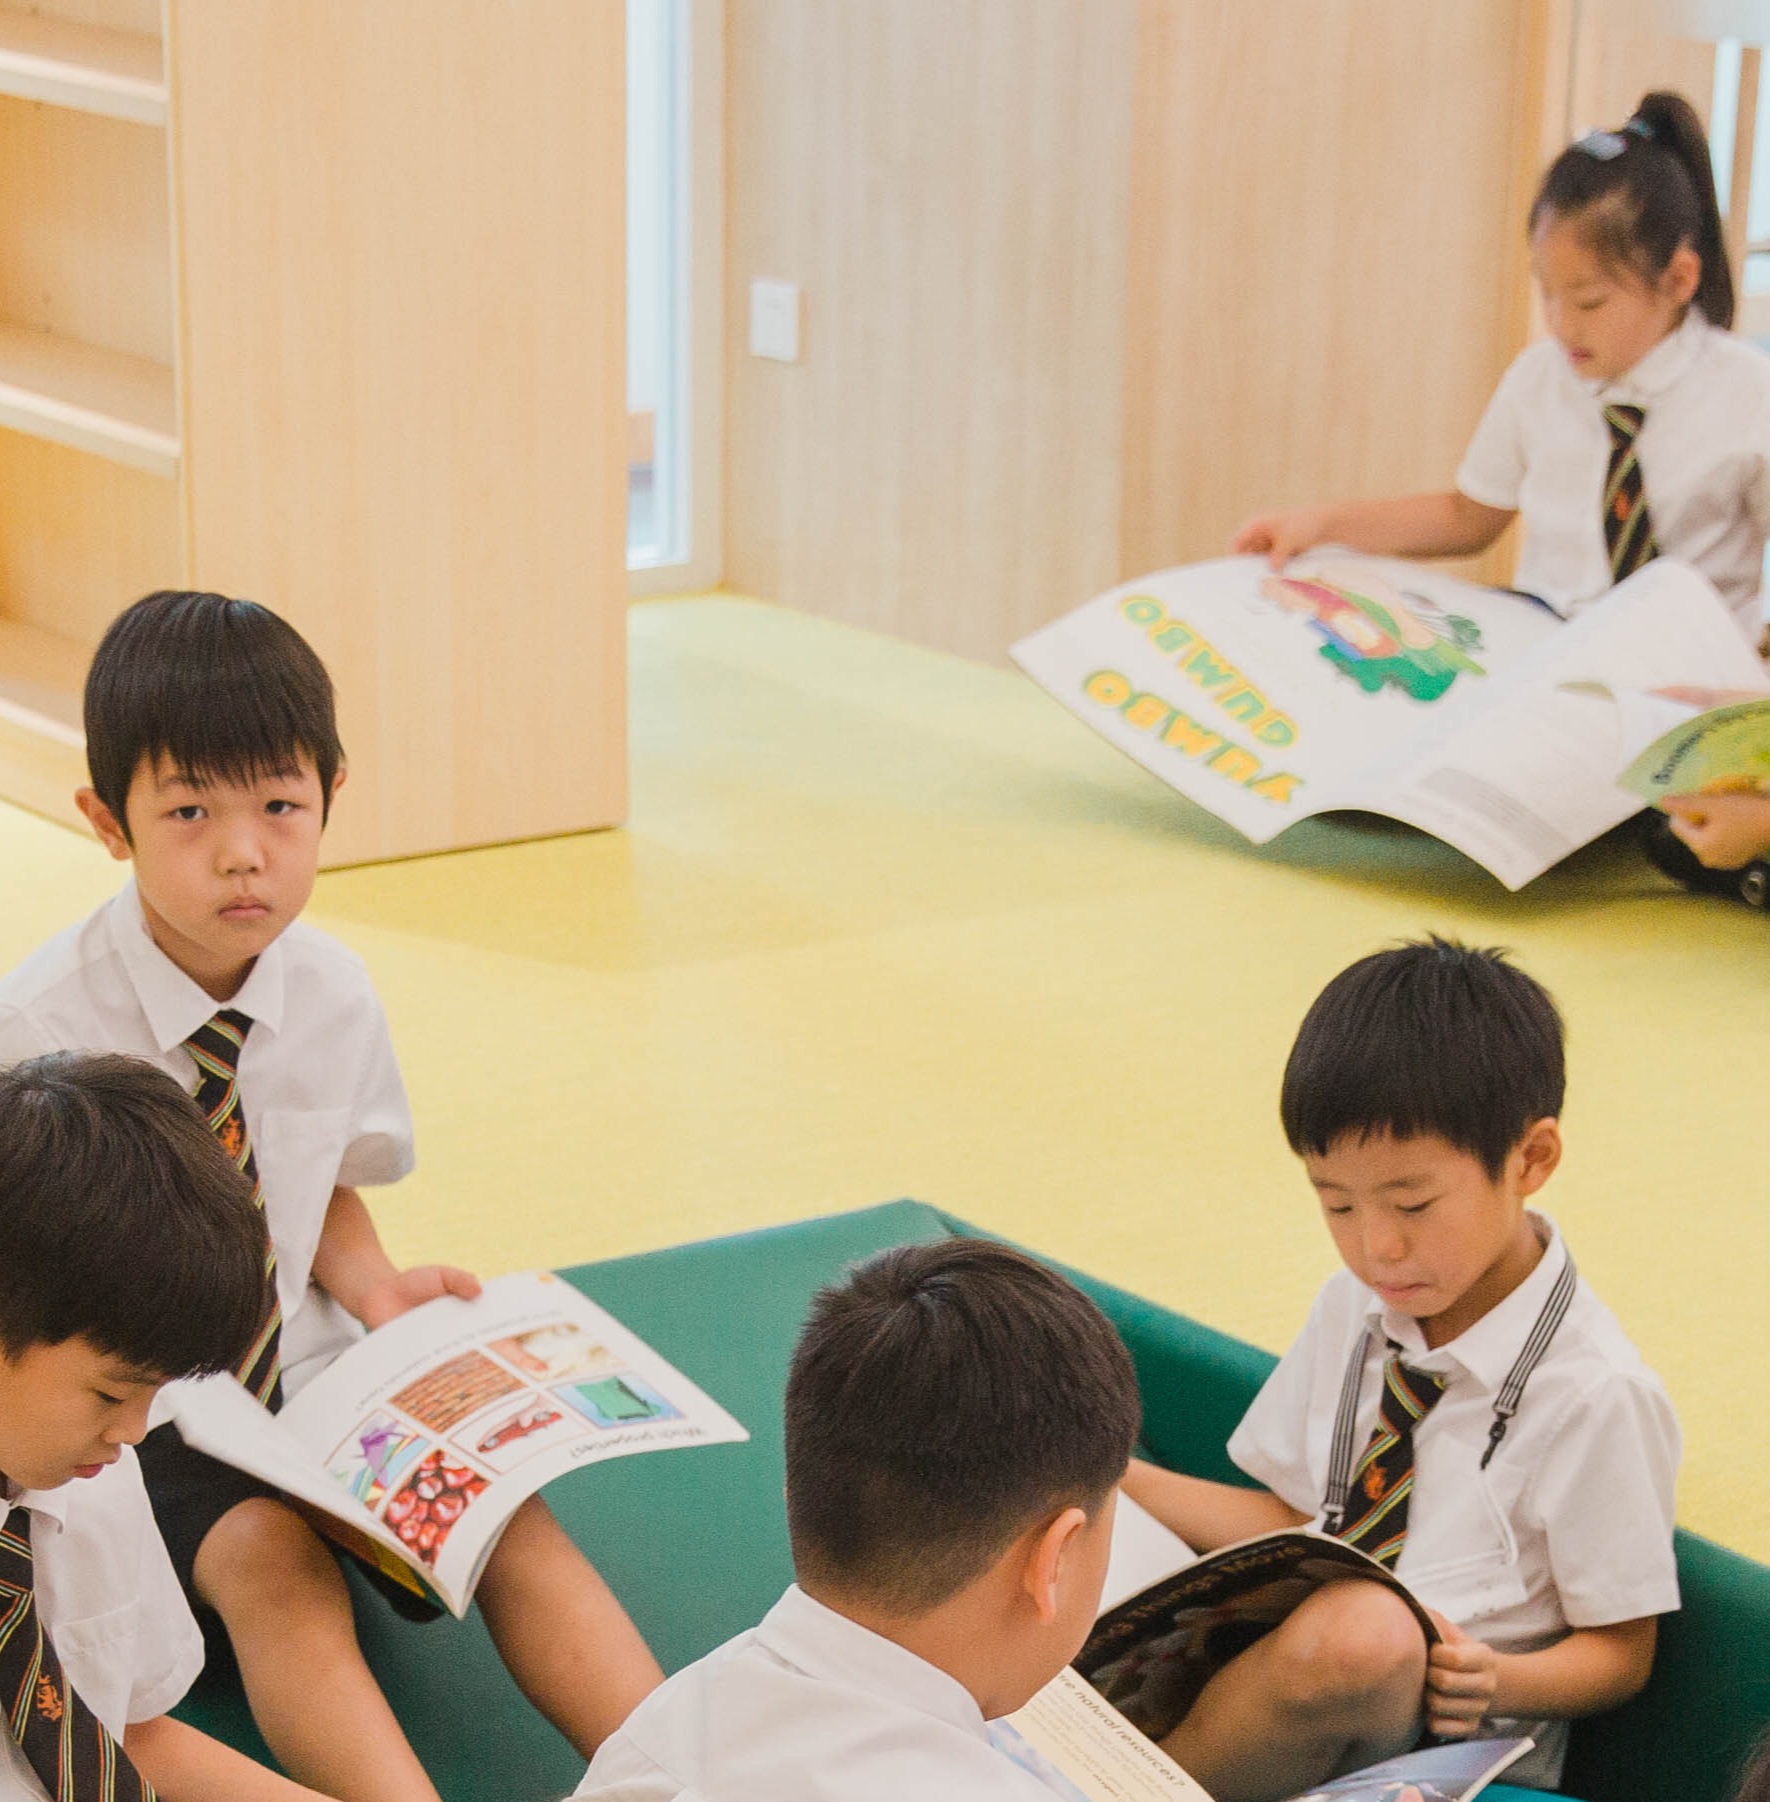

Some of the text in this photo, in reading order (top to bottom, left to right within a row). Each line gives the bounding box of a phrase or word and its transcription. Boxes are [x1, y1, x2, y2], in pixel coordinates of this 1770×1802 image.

[1083, 670, 1306, 804] YUMBO
[1075, 1691, 1122, 1730] natural
[1116, 1730, 1186, 1787] resources?
